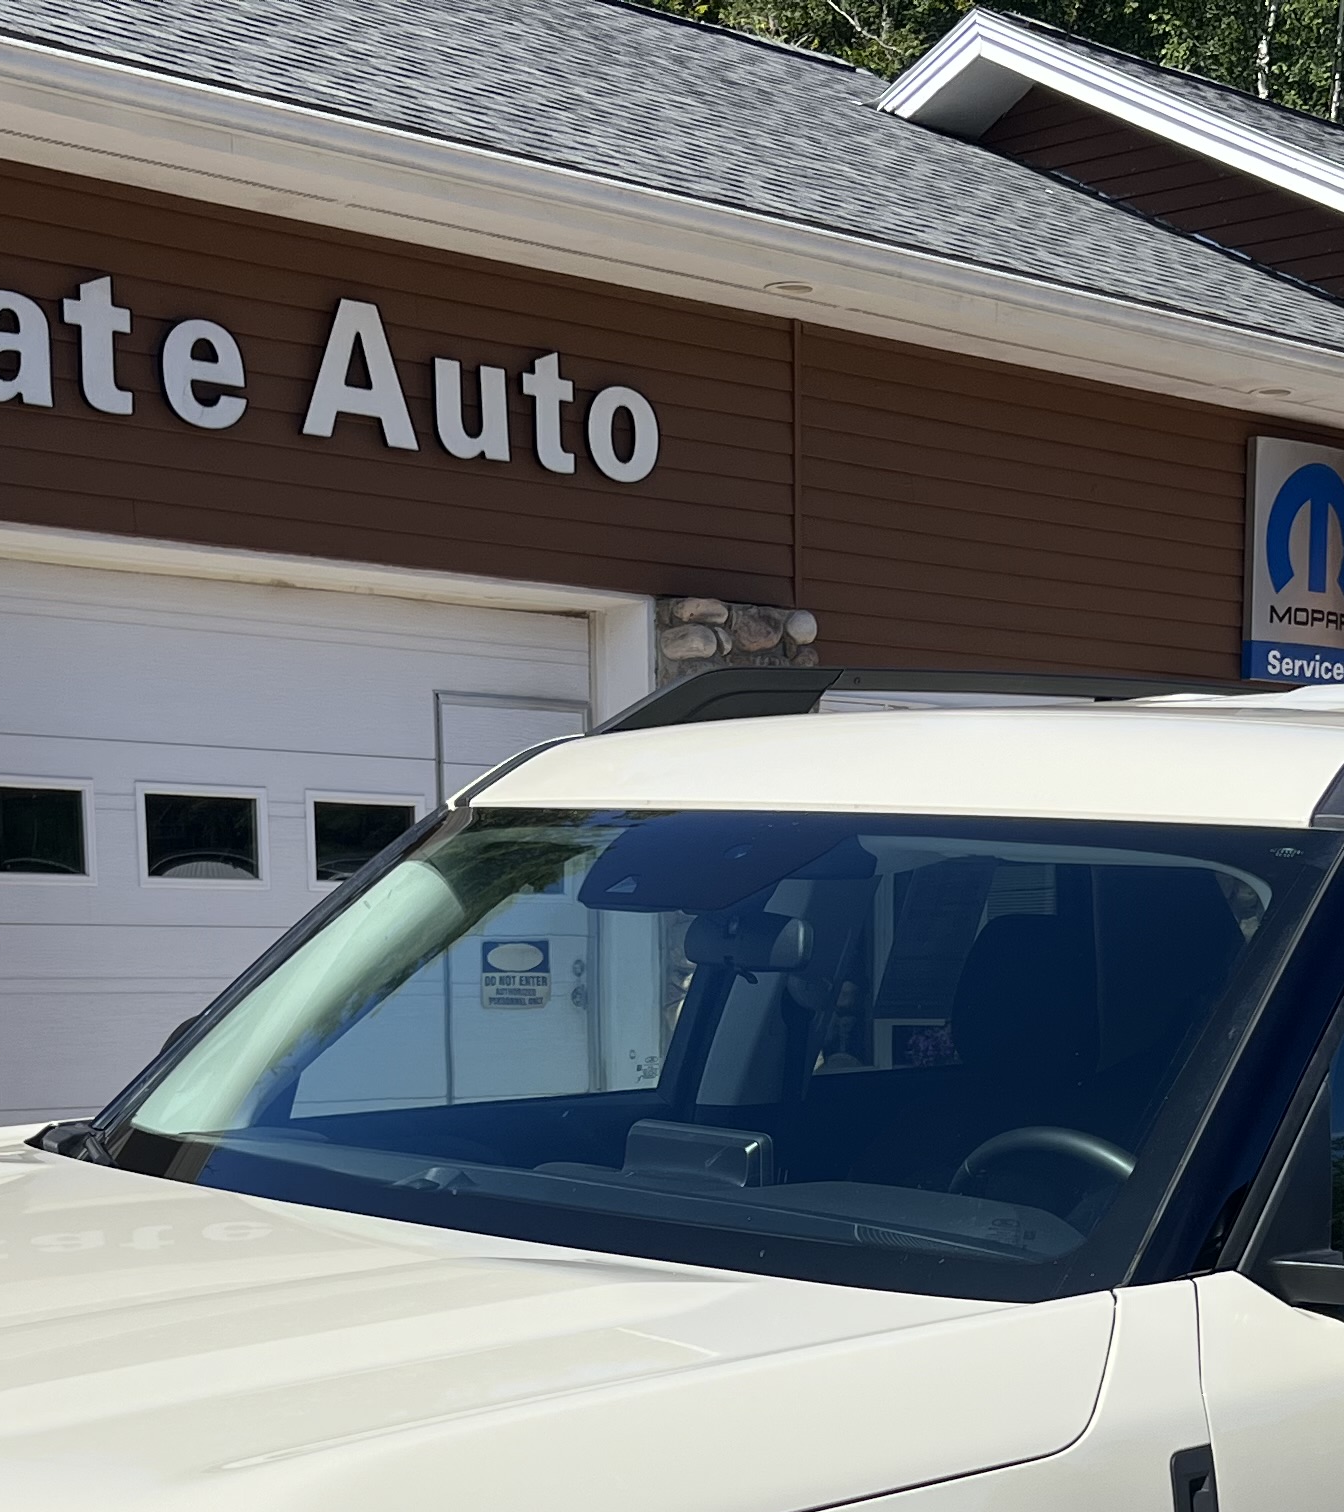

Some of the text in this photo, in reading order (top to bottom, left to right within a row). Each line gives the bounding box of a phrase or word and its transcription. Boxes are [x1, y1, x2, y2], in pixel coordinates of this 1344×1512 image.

[301, 296, 661, 483] Auto
[1267, 649, 1344, 680] Service
[485, 975, 547, 986] DO NOT ENTER
